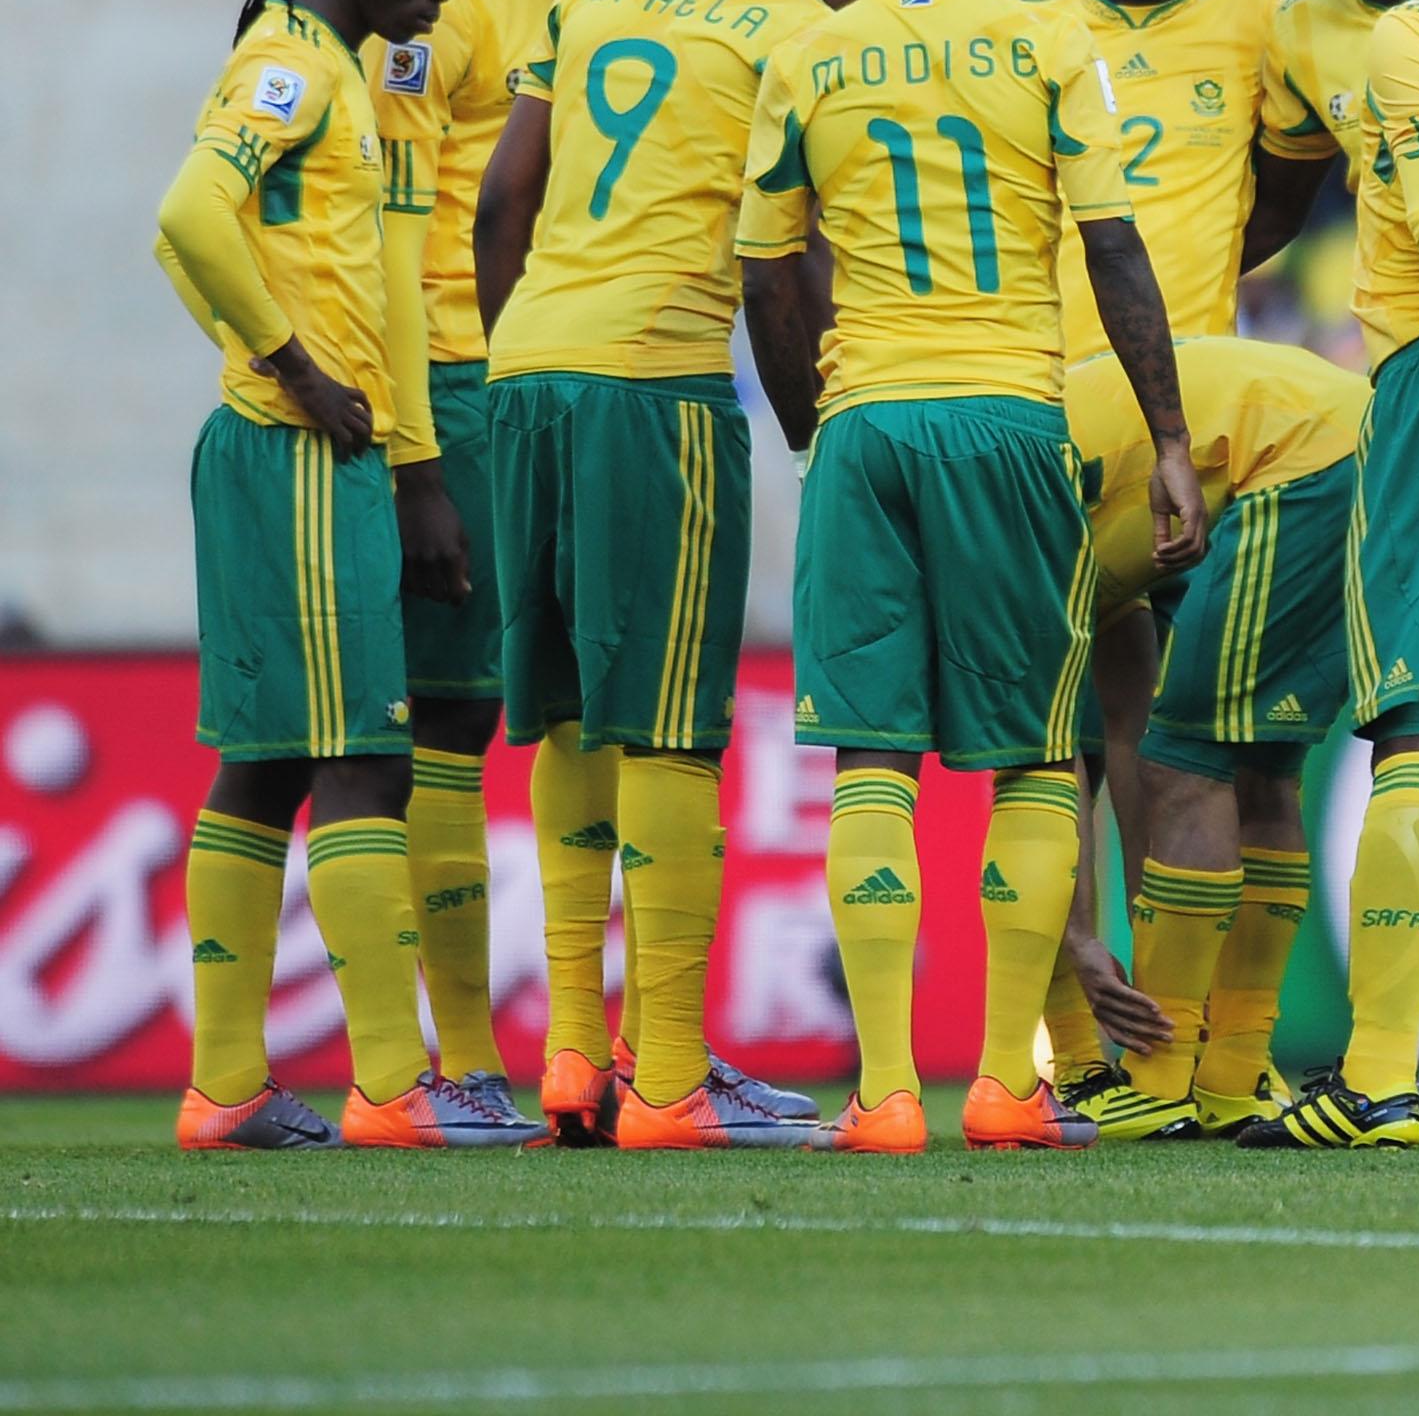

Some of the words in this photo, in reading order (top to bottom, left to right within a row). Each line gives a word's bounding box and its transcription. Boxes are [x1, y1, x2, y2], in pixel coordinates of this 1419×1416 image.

[811, 37, 1038, 97] MODISE
[586, 37, 678, 222] 9
[1120, 115, 1164, 187] 2
[867, 114, 1001, 297] 11
[1266, 711, 1308, 722] adidas
[425, 883, 485, 914] SAFA
[843, 890, 915, 904] adidas
